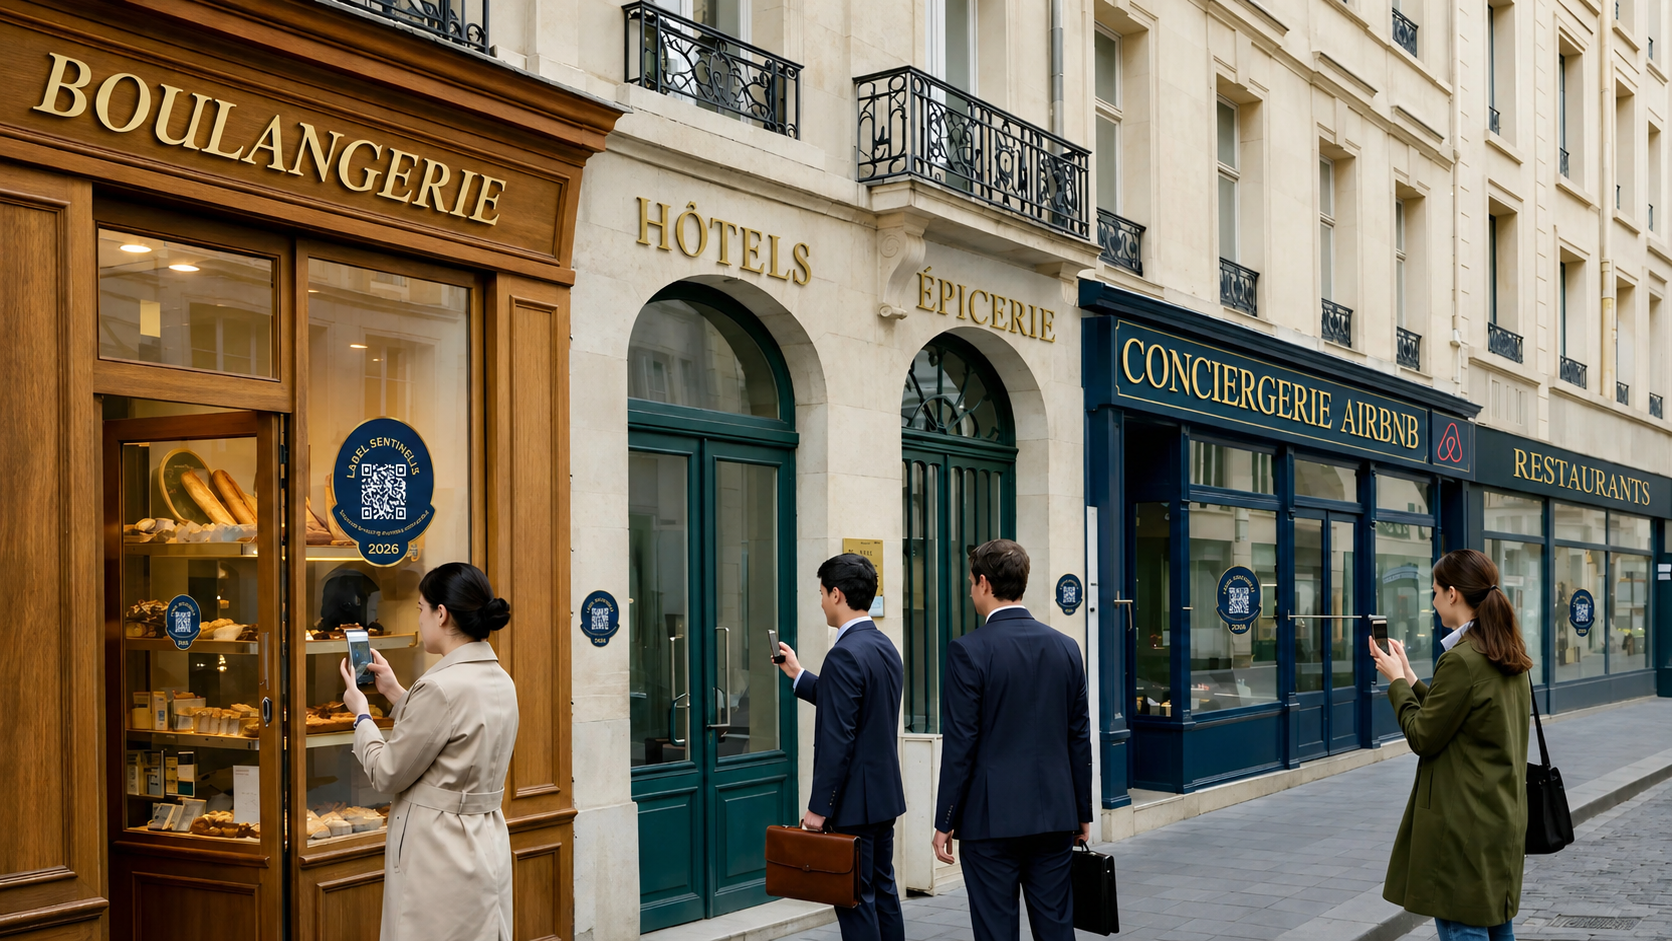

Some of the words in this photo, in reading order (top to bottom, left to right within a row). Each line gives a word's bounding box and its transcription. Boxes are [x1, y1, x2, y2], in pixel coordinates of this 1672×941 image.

[33, 52, 507, 226] BOULANGERIE
[636, 196, 811, 286] HÔTELS
[916, 267, 1056, 343] ÉPICERIE
[1121, 337, 1333, 430] CONCIERGERIE
[1341, 399, 1420, 450] AIRBNB
[1513, 448, 1651, 506] RESTAURANTS
[368, 543, 399, 555] 2026
